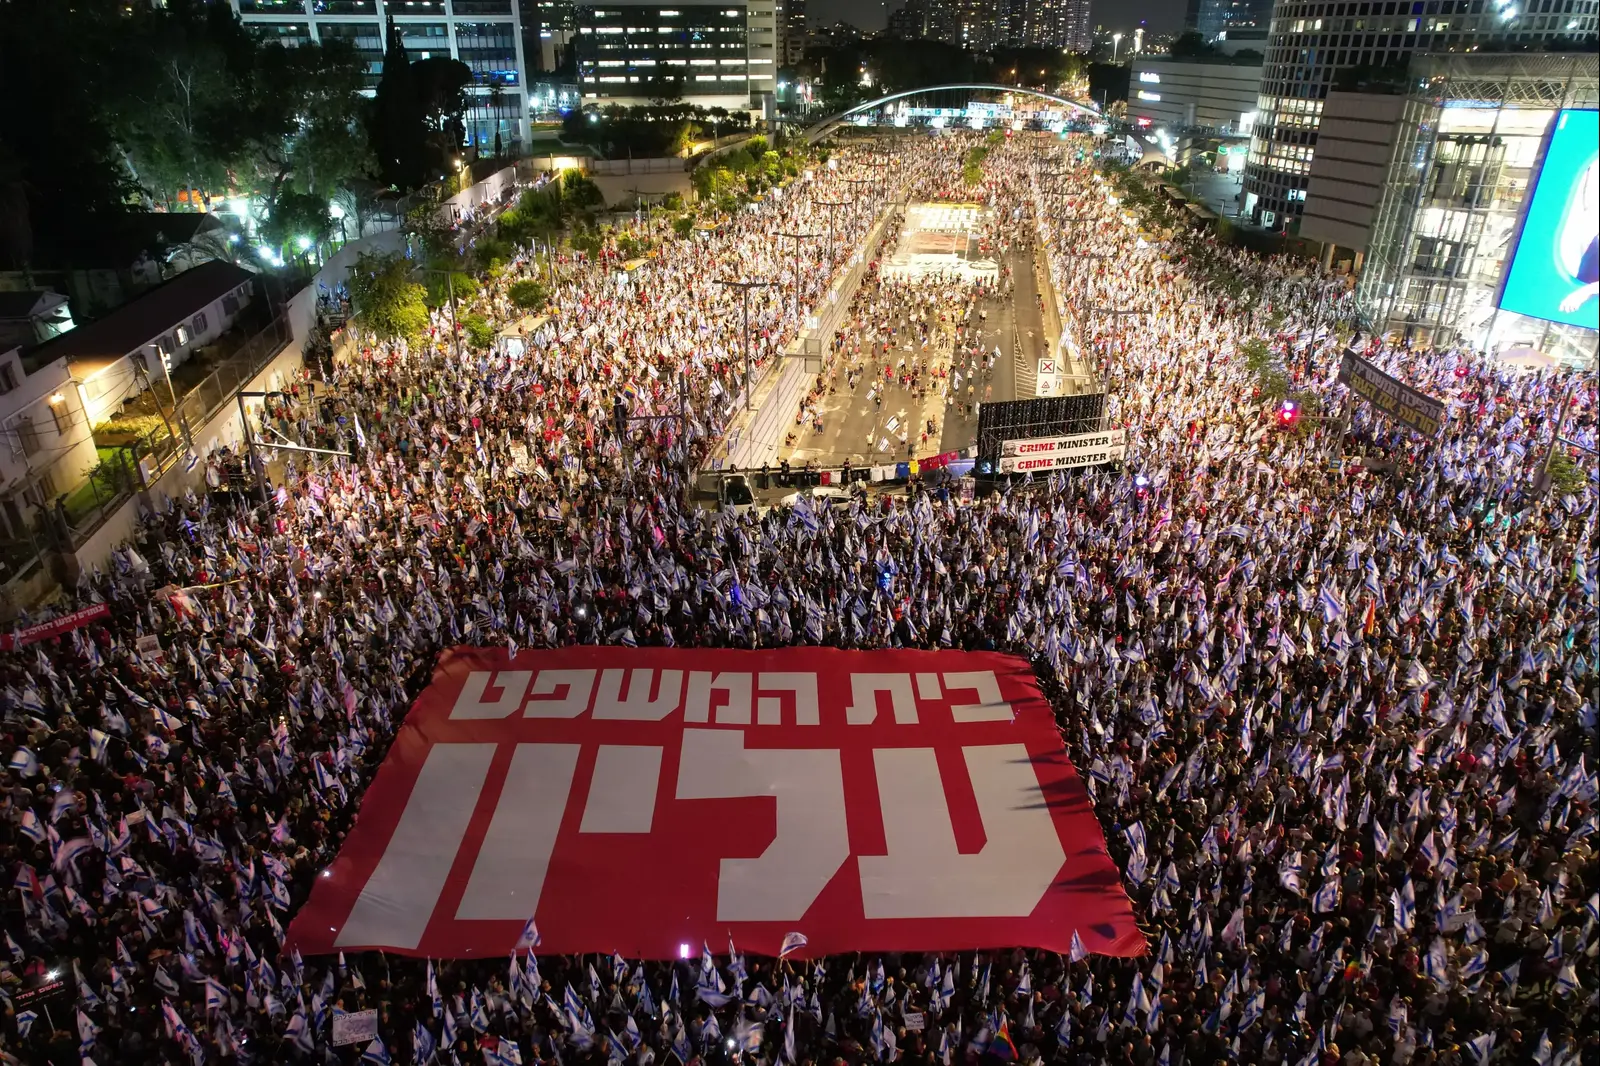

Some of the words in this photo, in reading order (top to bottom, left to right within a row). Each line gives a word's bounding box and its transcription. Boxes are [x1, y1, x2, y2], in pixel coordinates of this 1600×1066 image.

[1352, 359, 1400, 398] המשטרית
[1376, 389, 1398, 412] את
[1019, 442, 1055, 453] CRIME
[1057, 436, 1109, 450] MINISTER
[1017, 458, 1053, 470] CRIME
[1055, 452, 1107, 466] MINISTER
[55, 613, 78, 628] למען
[449, 668, 820, 726] המשפט
[846, 670, 1015, 725] בית
[334, 728, 1067, 950] עליון
